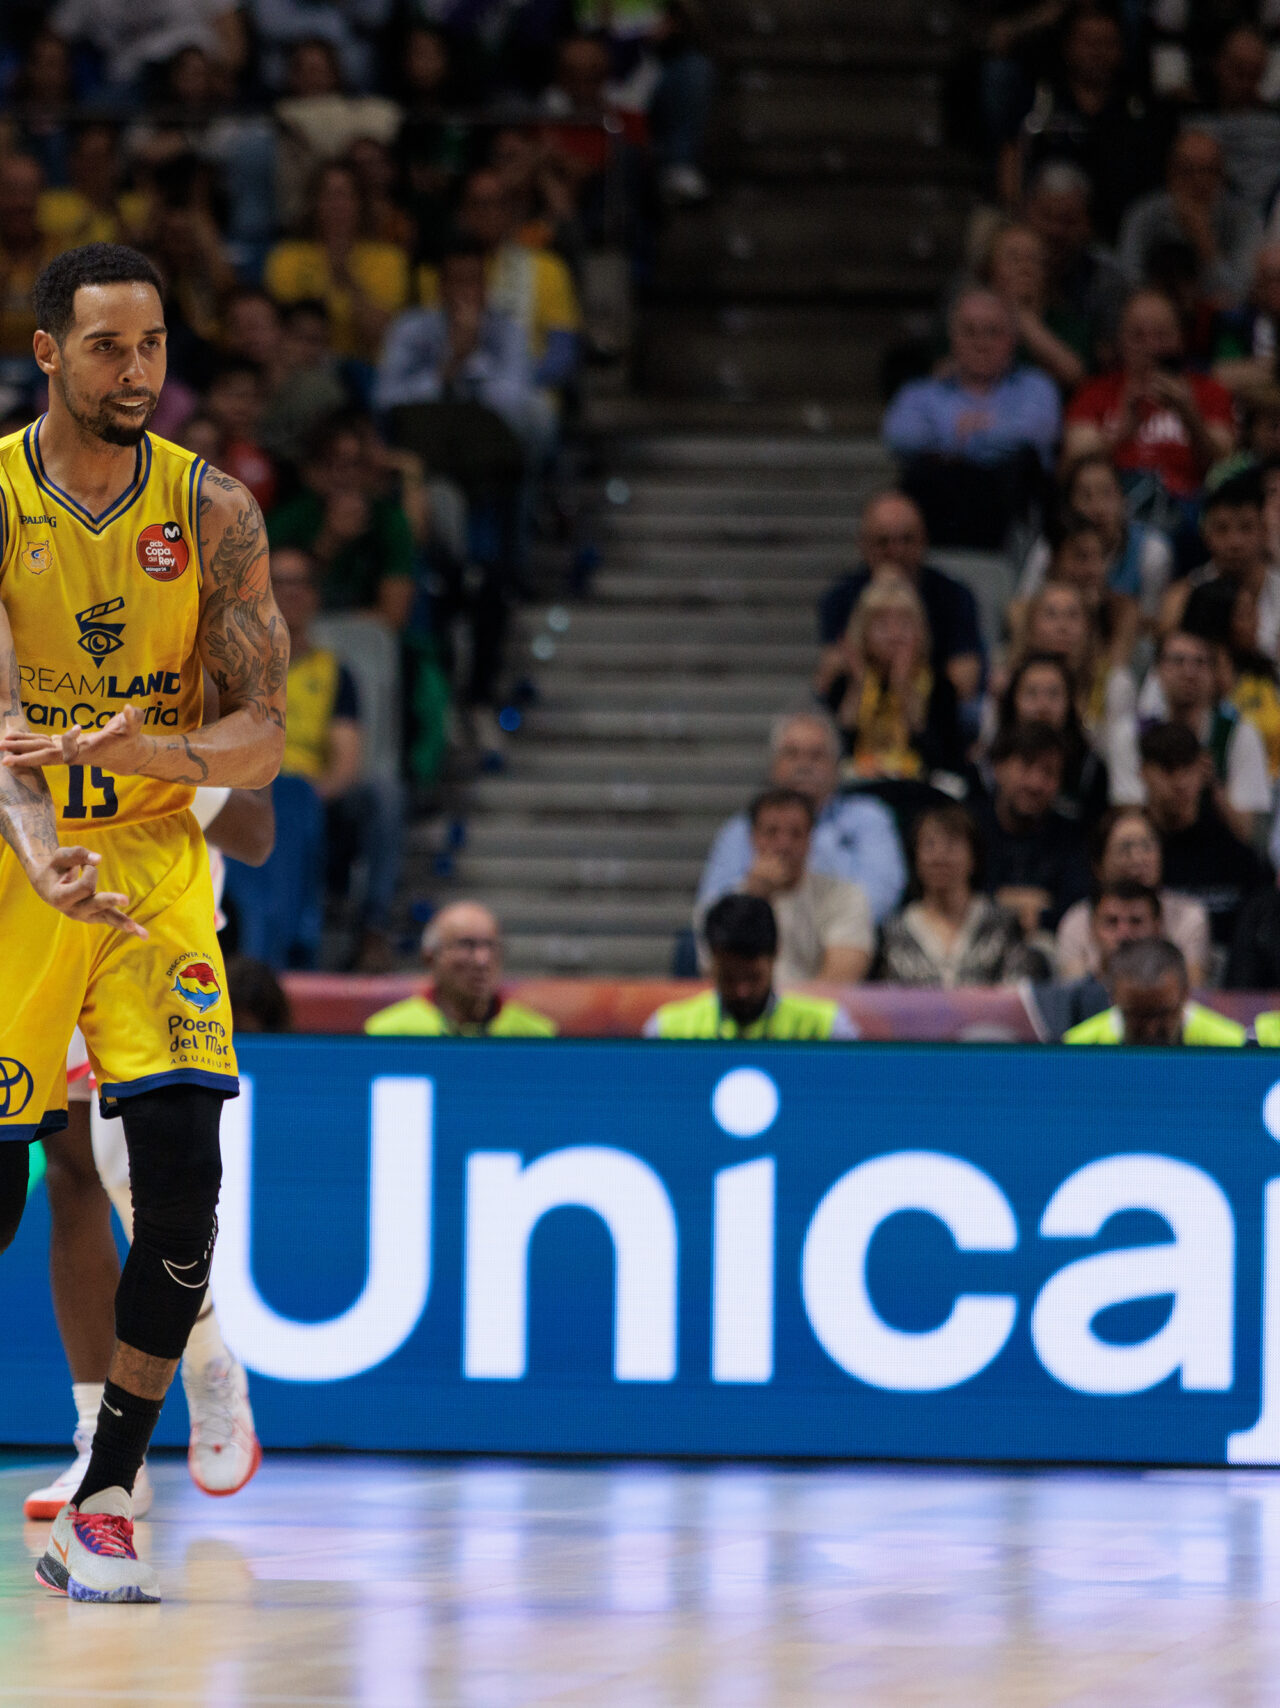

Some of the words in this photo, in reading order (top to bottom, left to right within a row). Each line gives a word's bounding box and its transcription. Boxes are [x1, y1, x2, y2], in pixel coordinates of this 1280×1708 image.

[145, 547, 171, 557] Copa
[158, 556, 176, 567] Rey
[19, 664, 181, 699] REAMLAND
[63, 764, 119, 819] 15
[170, 1035, 199, 1053] del
